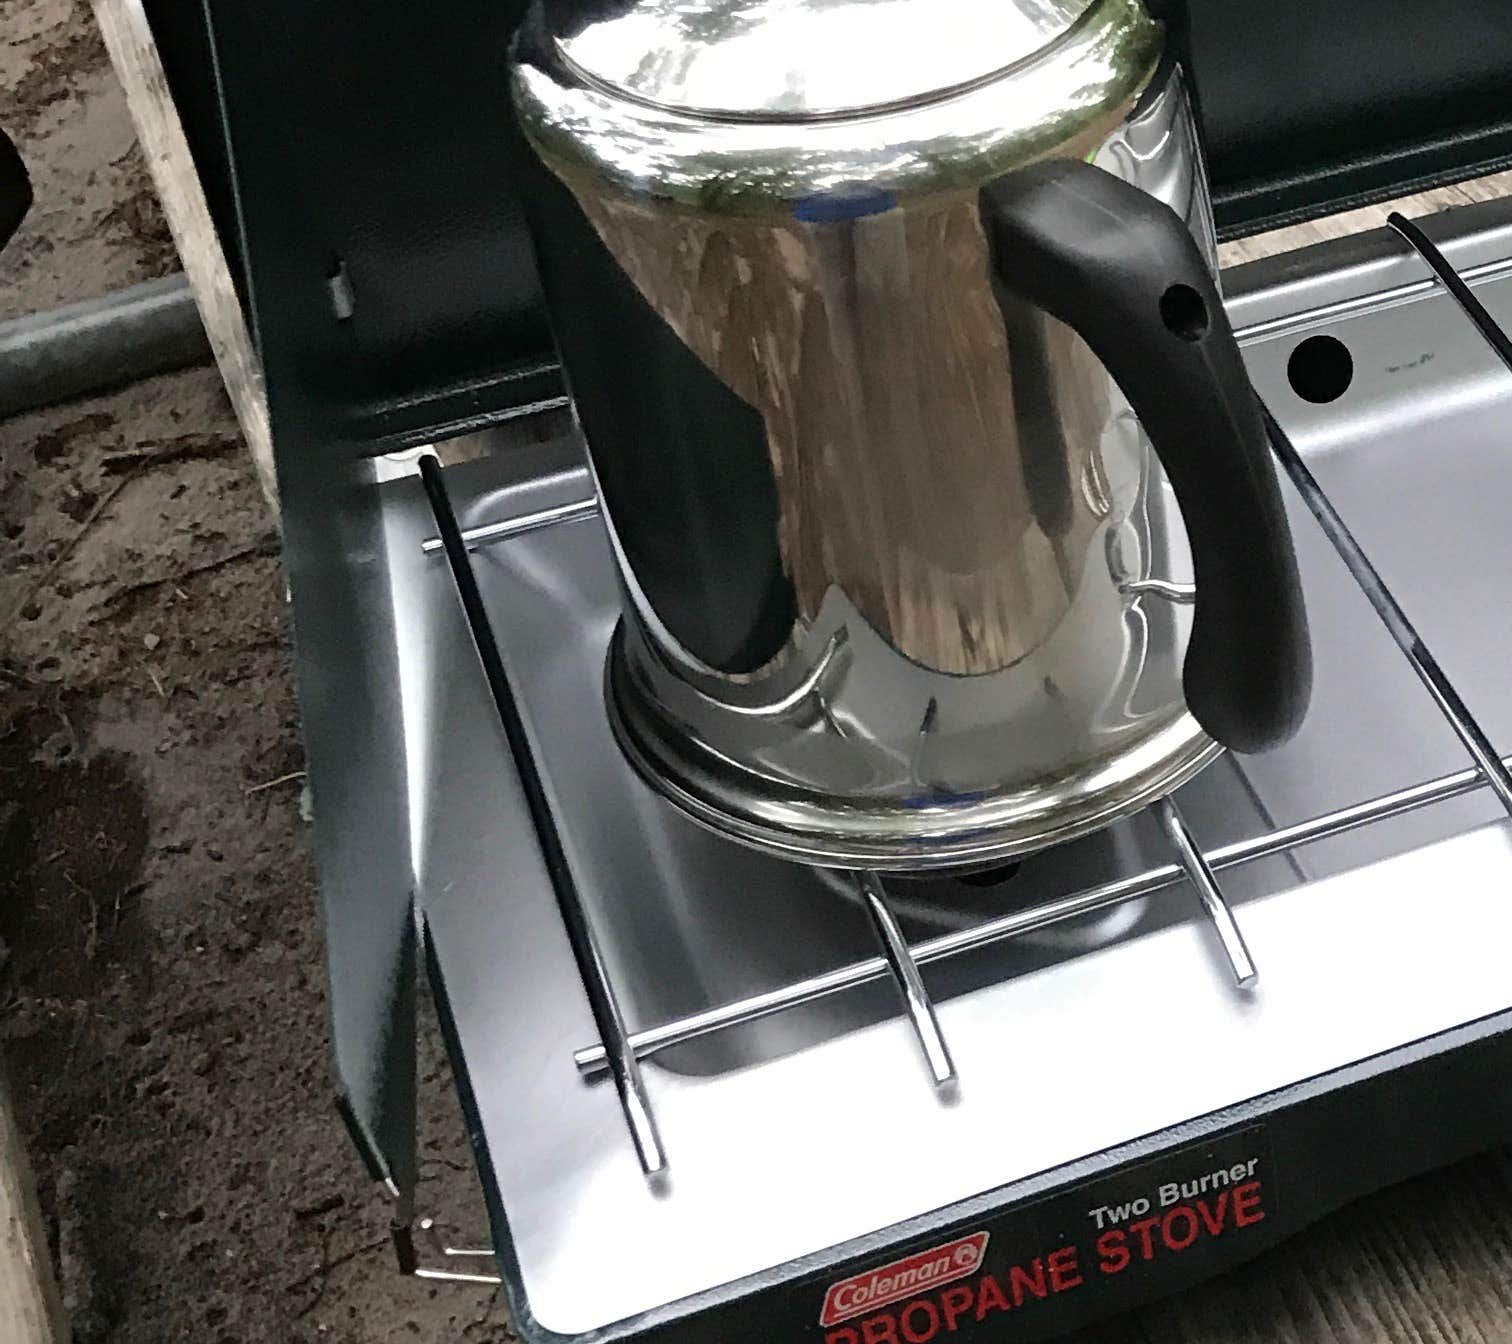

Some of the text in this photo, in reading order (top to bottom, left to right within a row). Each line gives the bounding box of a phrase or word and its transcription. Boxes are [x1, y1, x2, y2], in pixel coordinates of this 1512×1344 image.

[1088, 1157, 1260, 1229] Two Burner
[1095, 1181, 1266, 1274] STOVE
[833, 1257, 950, 1314] Coleman
